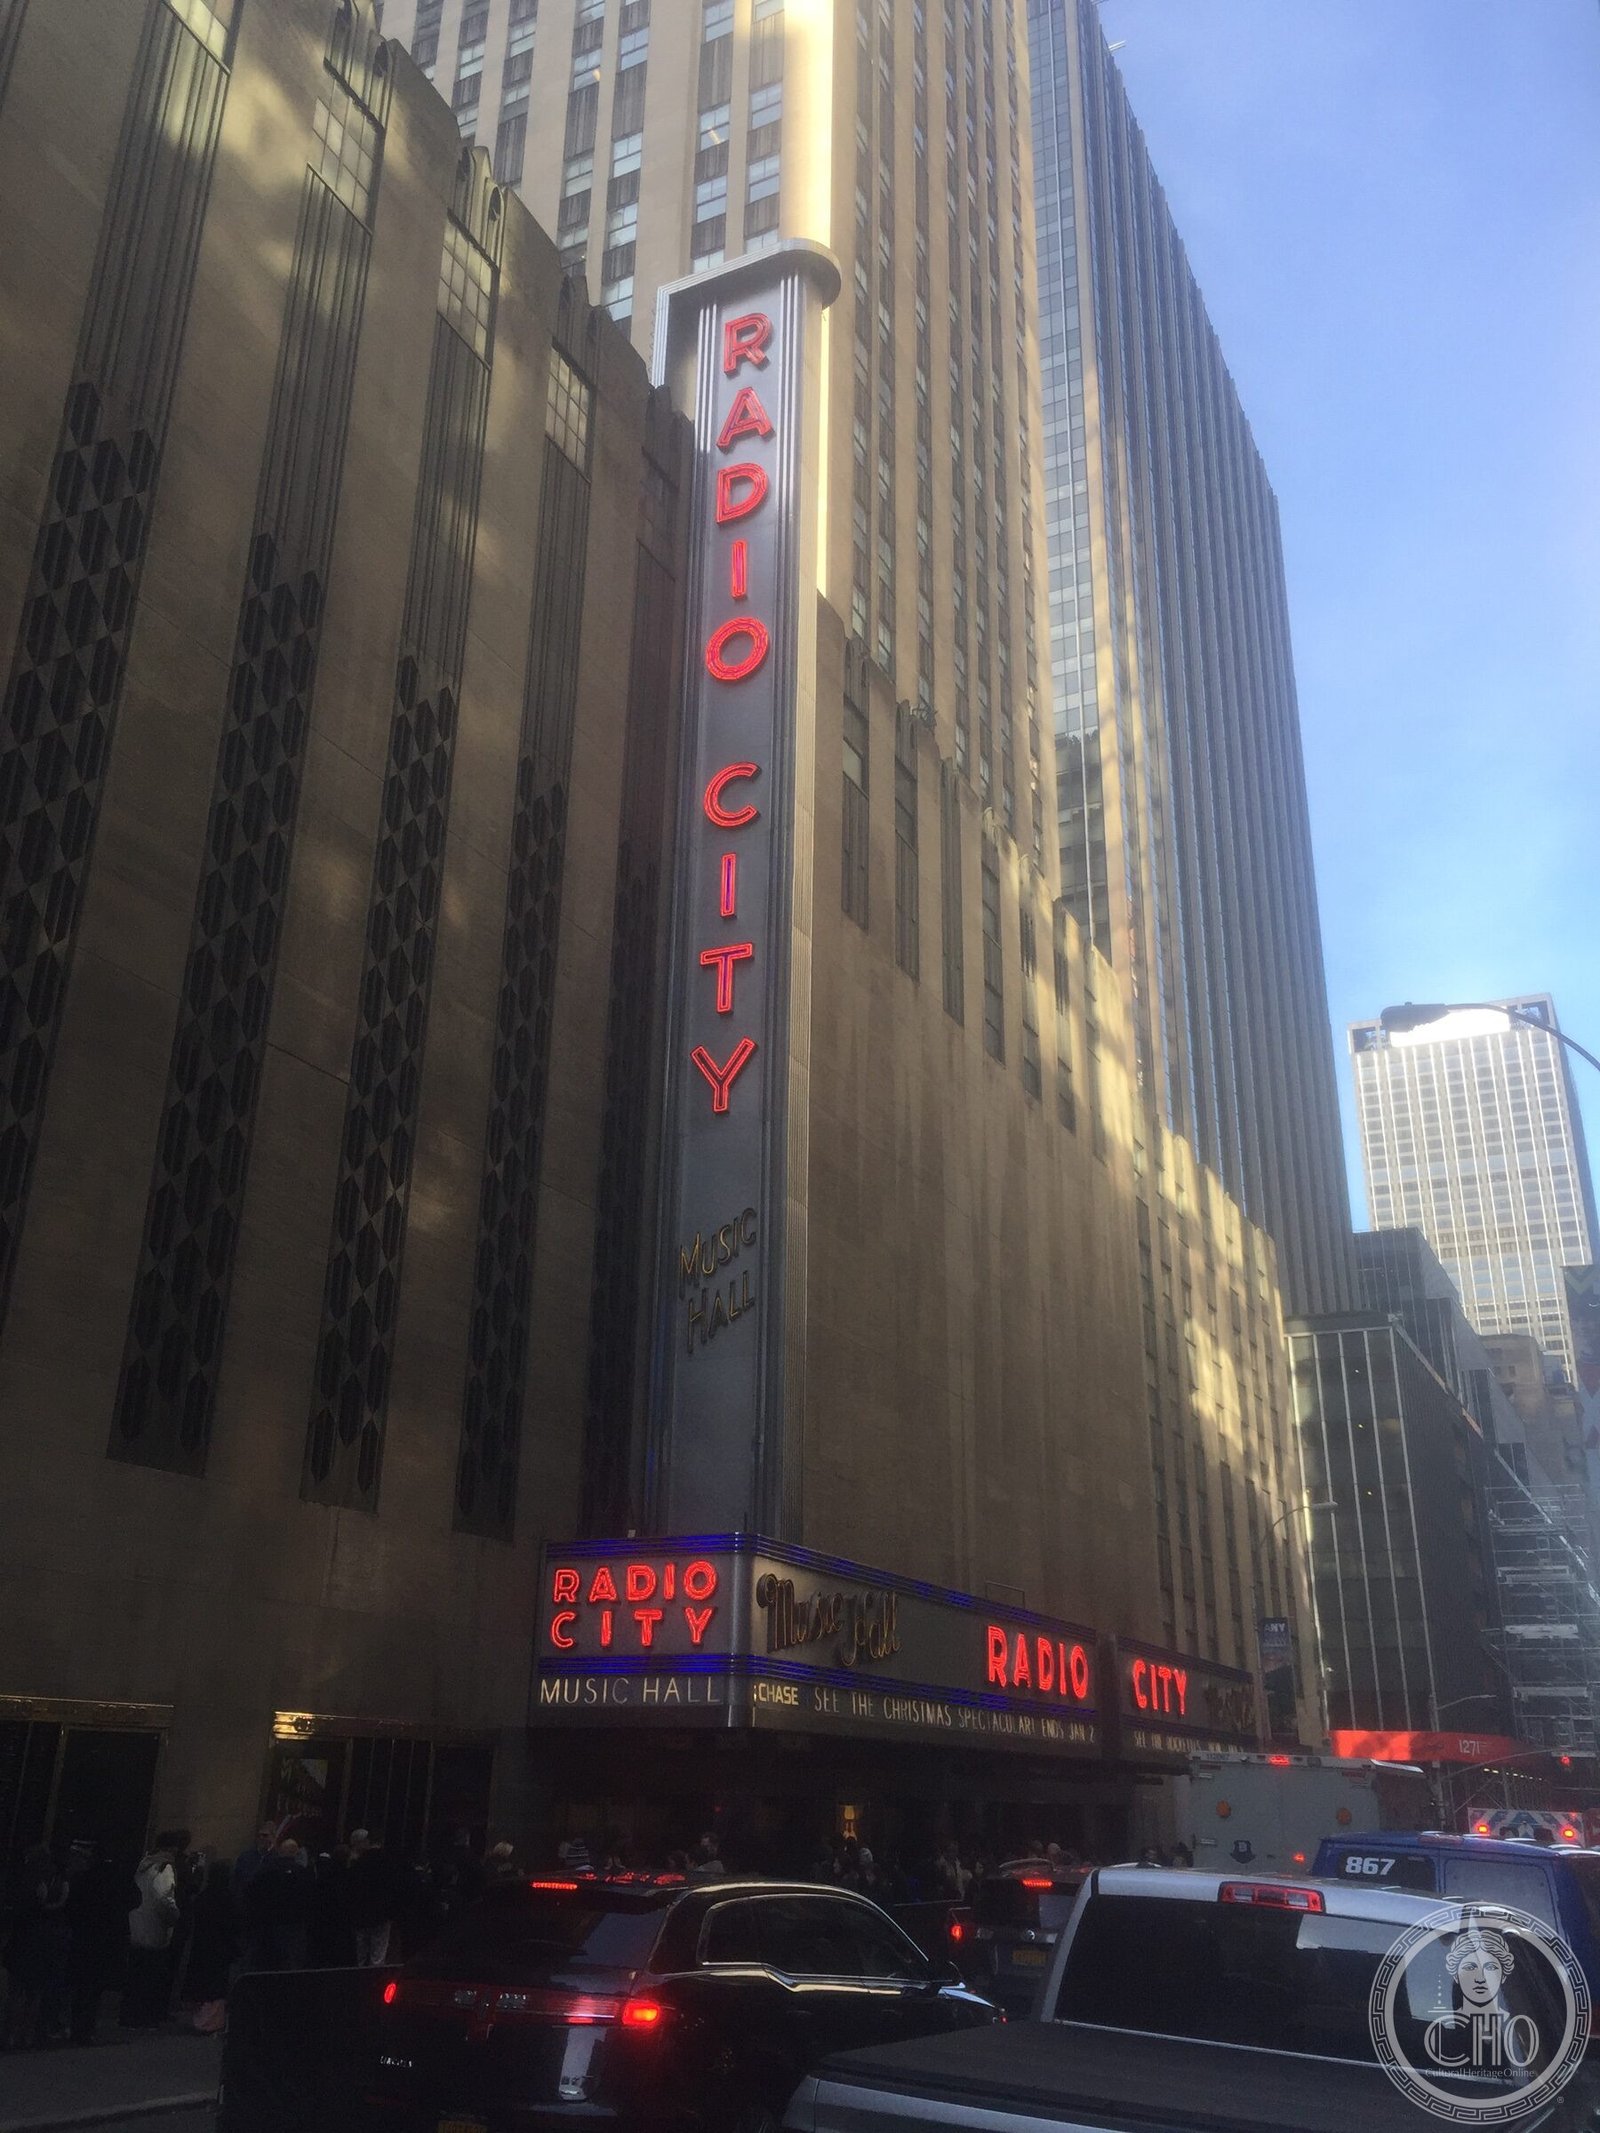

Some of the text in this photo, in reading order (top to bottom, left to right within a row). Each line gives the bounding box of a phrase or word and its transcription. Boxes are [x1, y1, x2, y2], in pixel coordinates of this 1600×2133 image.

[705, 312, 773, 681] RADIO
[691, 762, 759, 1112] CITY
[678, 1208, 757, 1299] MUSIC
[687, 1270, 755, 1353] HALL
[553, 1560, 718, 1603] RADIO
[551, 1607, 714, 1648] CITY
[986, 1624, 1089, 1700] RADIO
[1132, 1658, 1187, 1715] CITY
[540, 1676, 721, 1704] MUSIC HALL
[758, 1682, 799, 1706] CHASE
[814, 1687, 839, 1713] SEE
[851, 1690, 875, 1718] THE
[883, 1696, 951, 1727] CHRISTMAS
[1041, 1717, 1065, 1740] ENDS
[1458, 1739, 1481, 1757] 1271
[1345, 1856, 1396, 1876] 867
